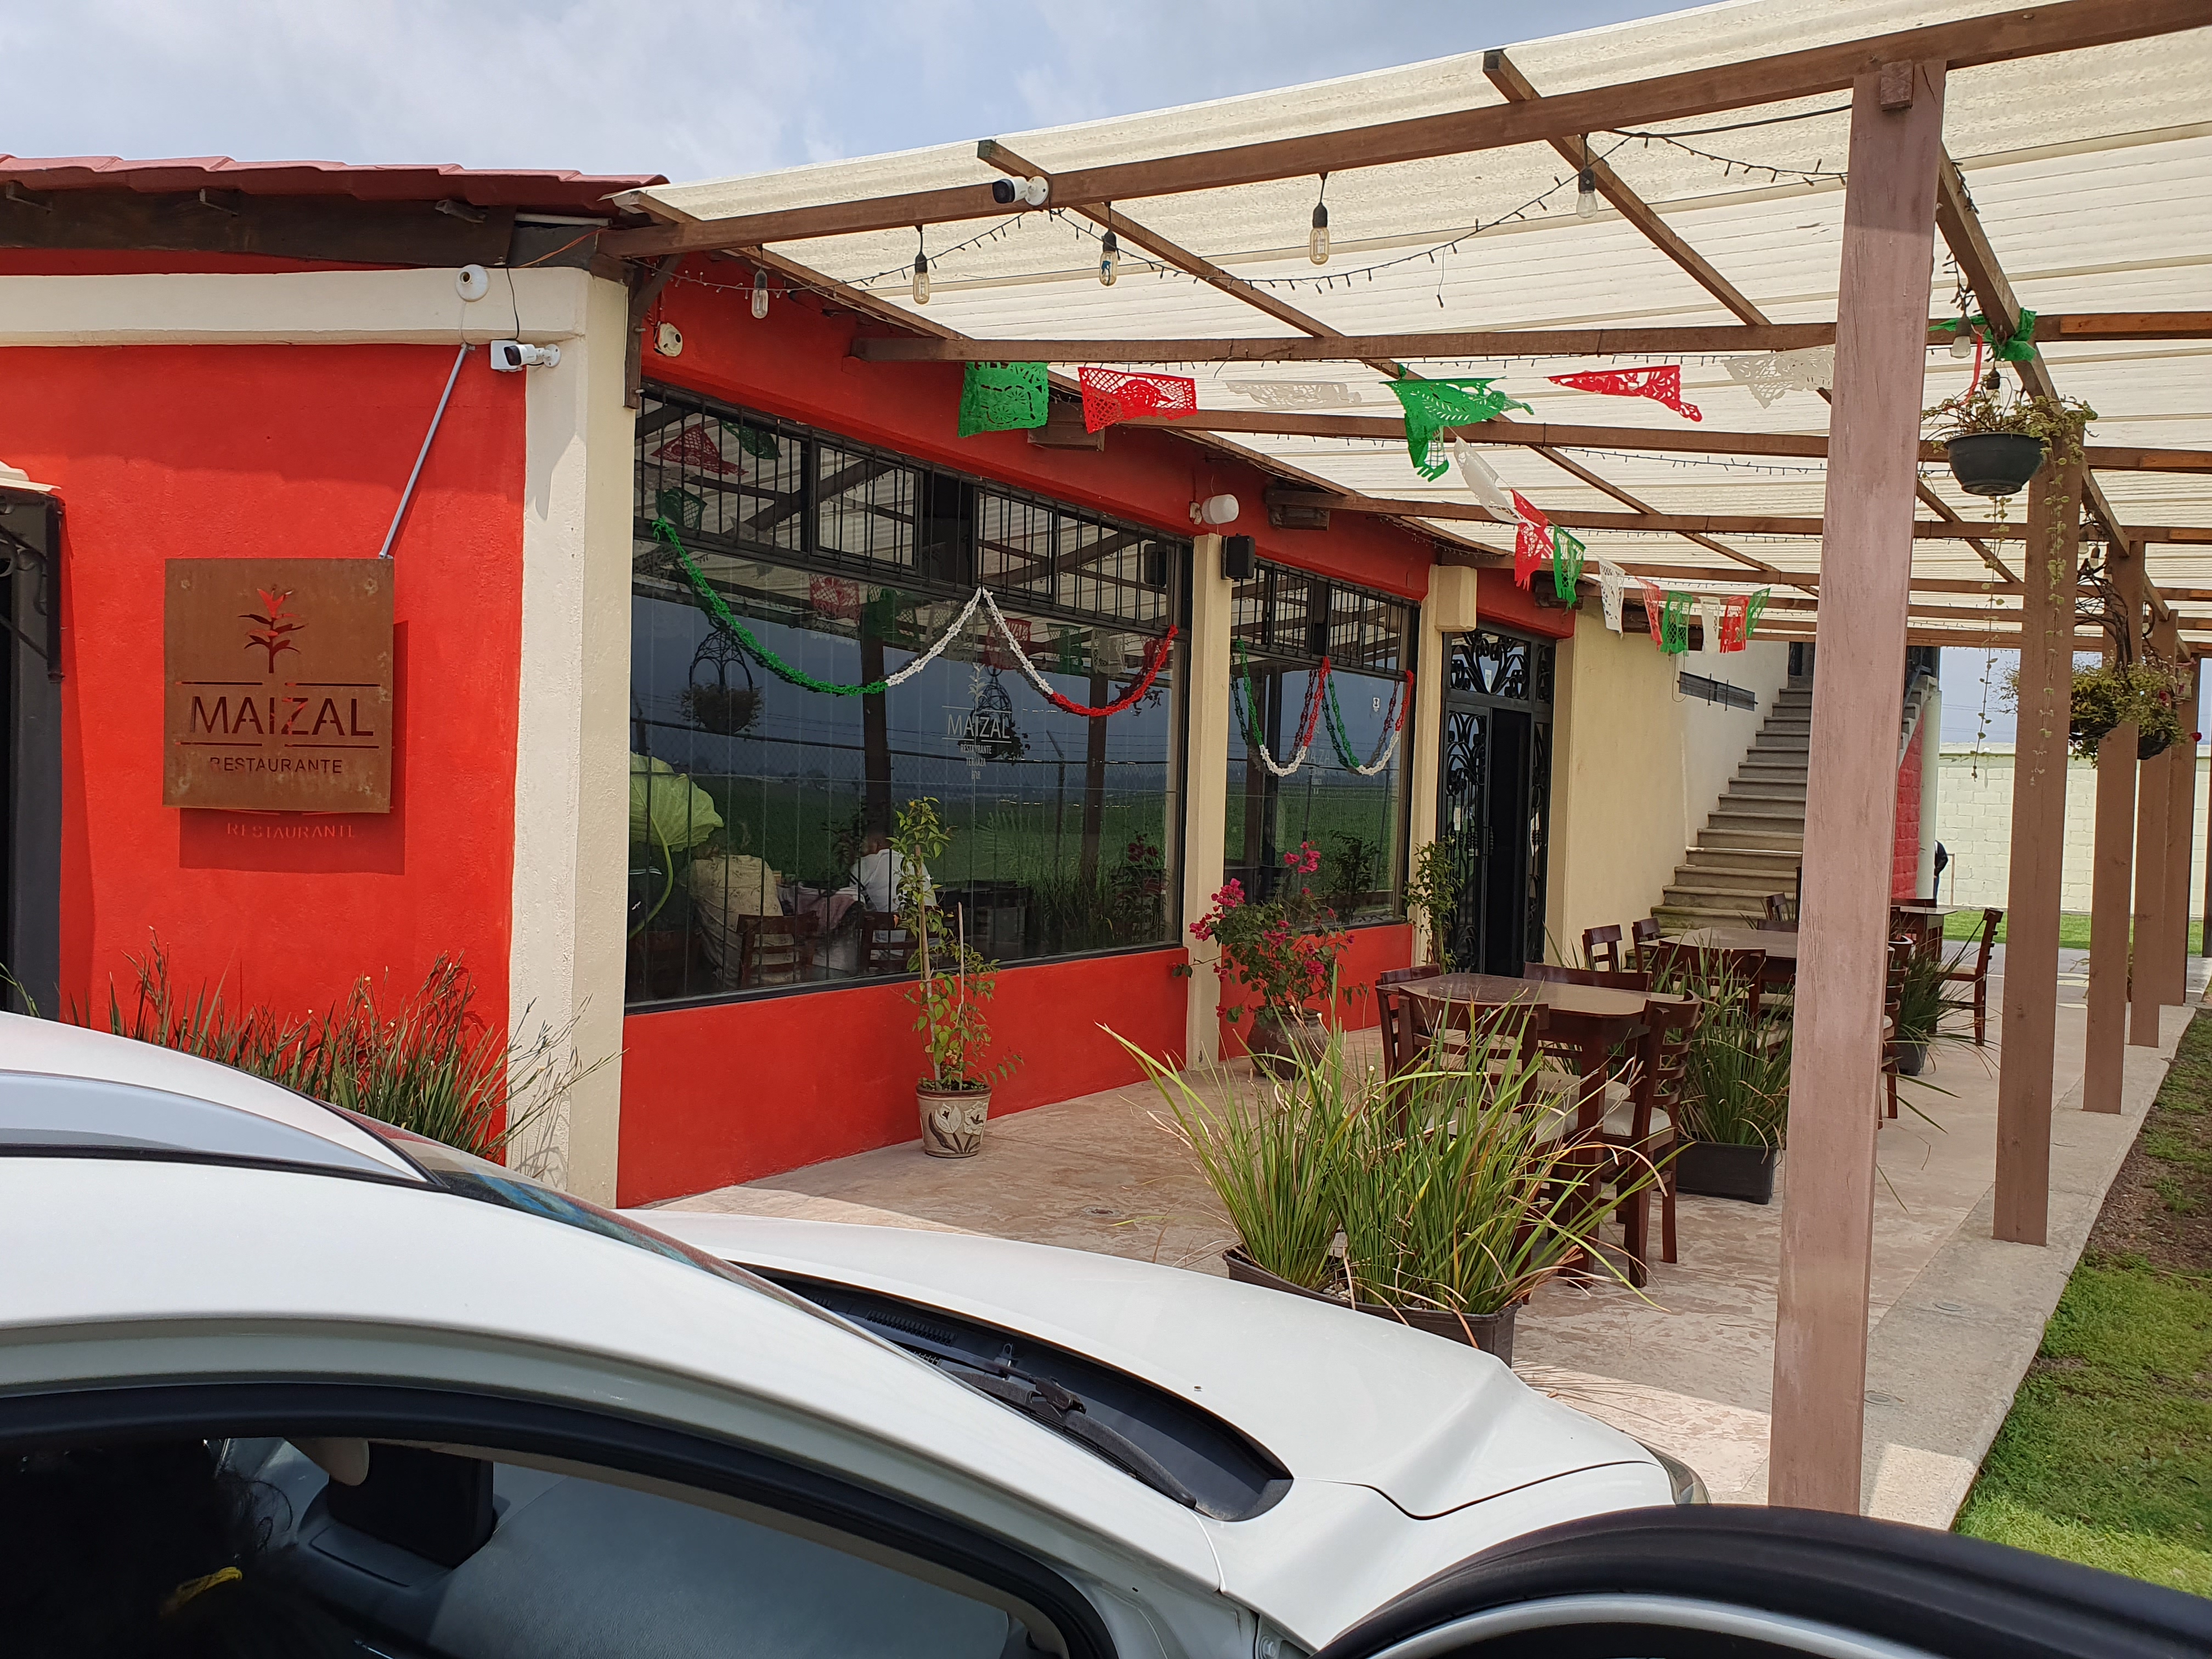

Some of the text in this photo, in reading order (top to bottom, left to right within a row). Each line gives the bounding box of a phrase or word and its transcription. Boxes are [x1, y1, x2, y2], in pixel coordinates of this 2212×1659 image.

[191, 696, 374, 736] MAIZAL
[947, 714, 1010, 738] MAIZAL
[961, 744, 992, 754] RESTAURANTE
[210, 757, 343, 774] RESTAURANTE
